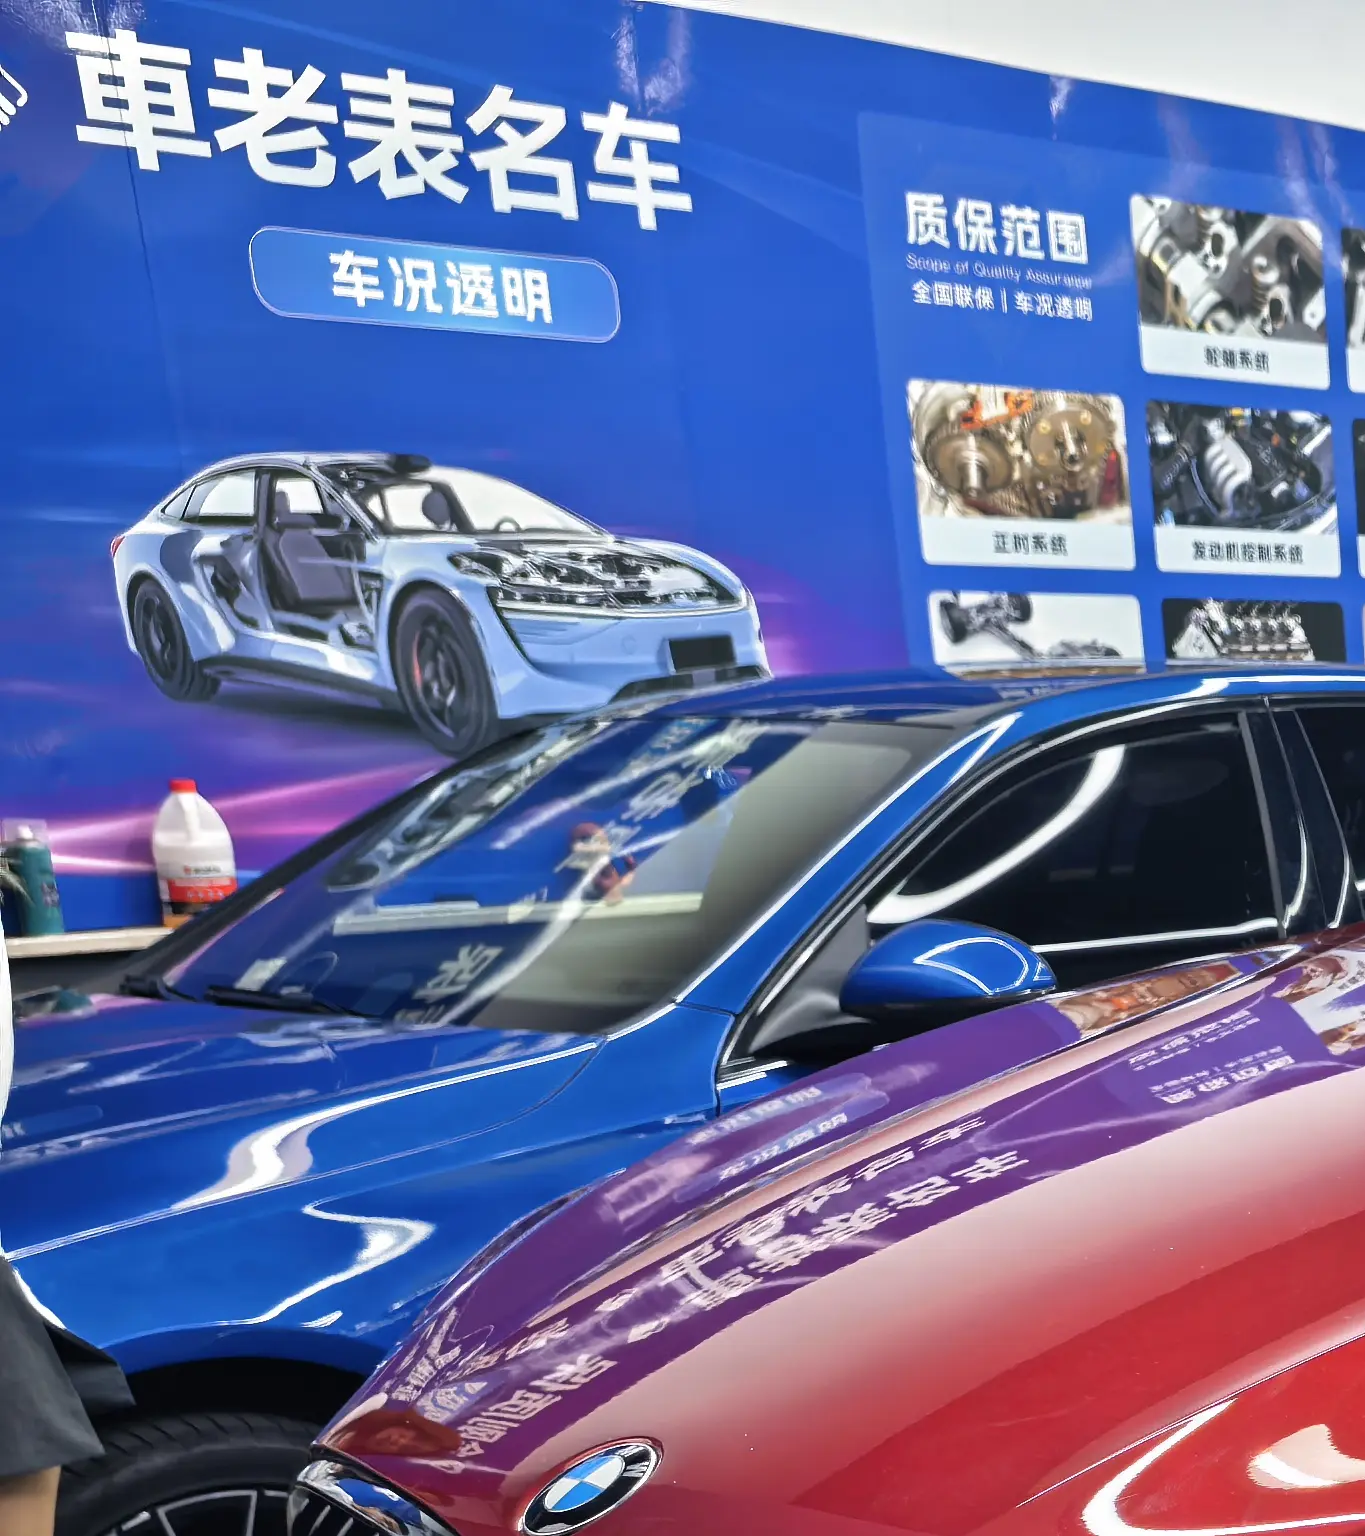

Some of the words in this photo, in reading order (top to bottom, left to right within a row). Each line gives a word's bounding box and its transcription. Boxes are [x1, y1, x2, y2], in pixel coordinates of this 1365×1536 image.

[65, 29, 692, 230] 車老表名车
[905, 191, 1088, 265] 质保范围
[329, 249, 553, 324] 车况透明
[905, 253, 951, 273] Scope
[954, 260, 969, 275] of
[973, 259, 1021, 283] Quality
[912, 279, 995, 310] 全国联保
[1014, 290, 1093, 321] 车况透明
[993, 531, 1068, 556] 正时系统
[1191, 538, 1304, 565] 发动机控制系统
